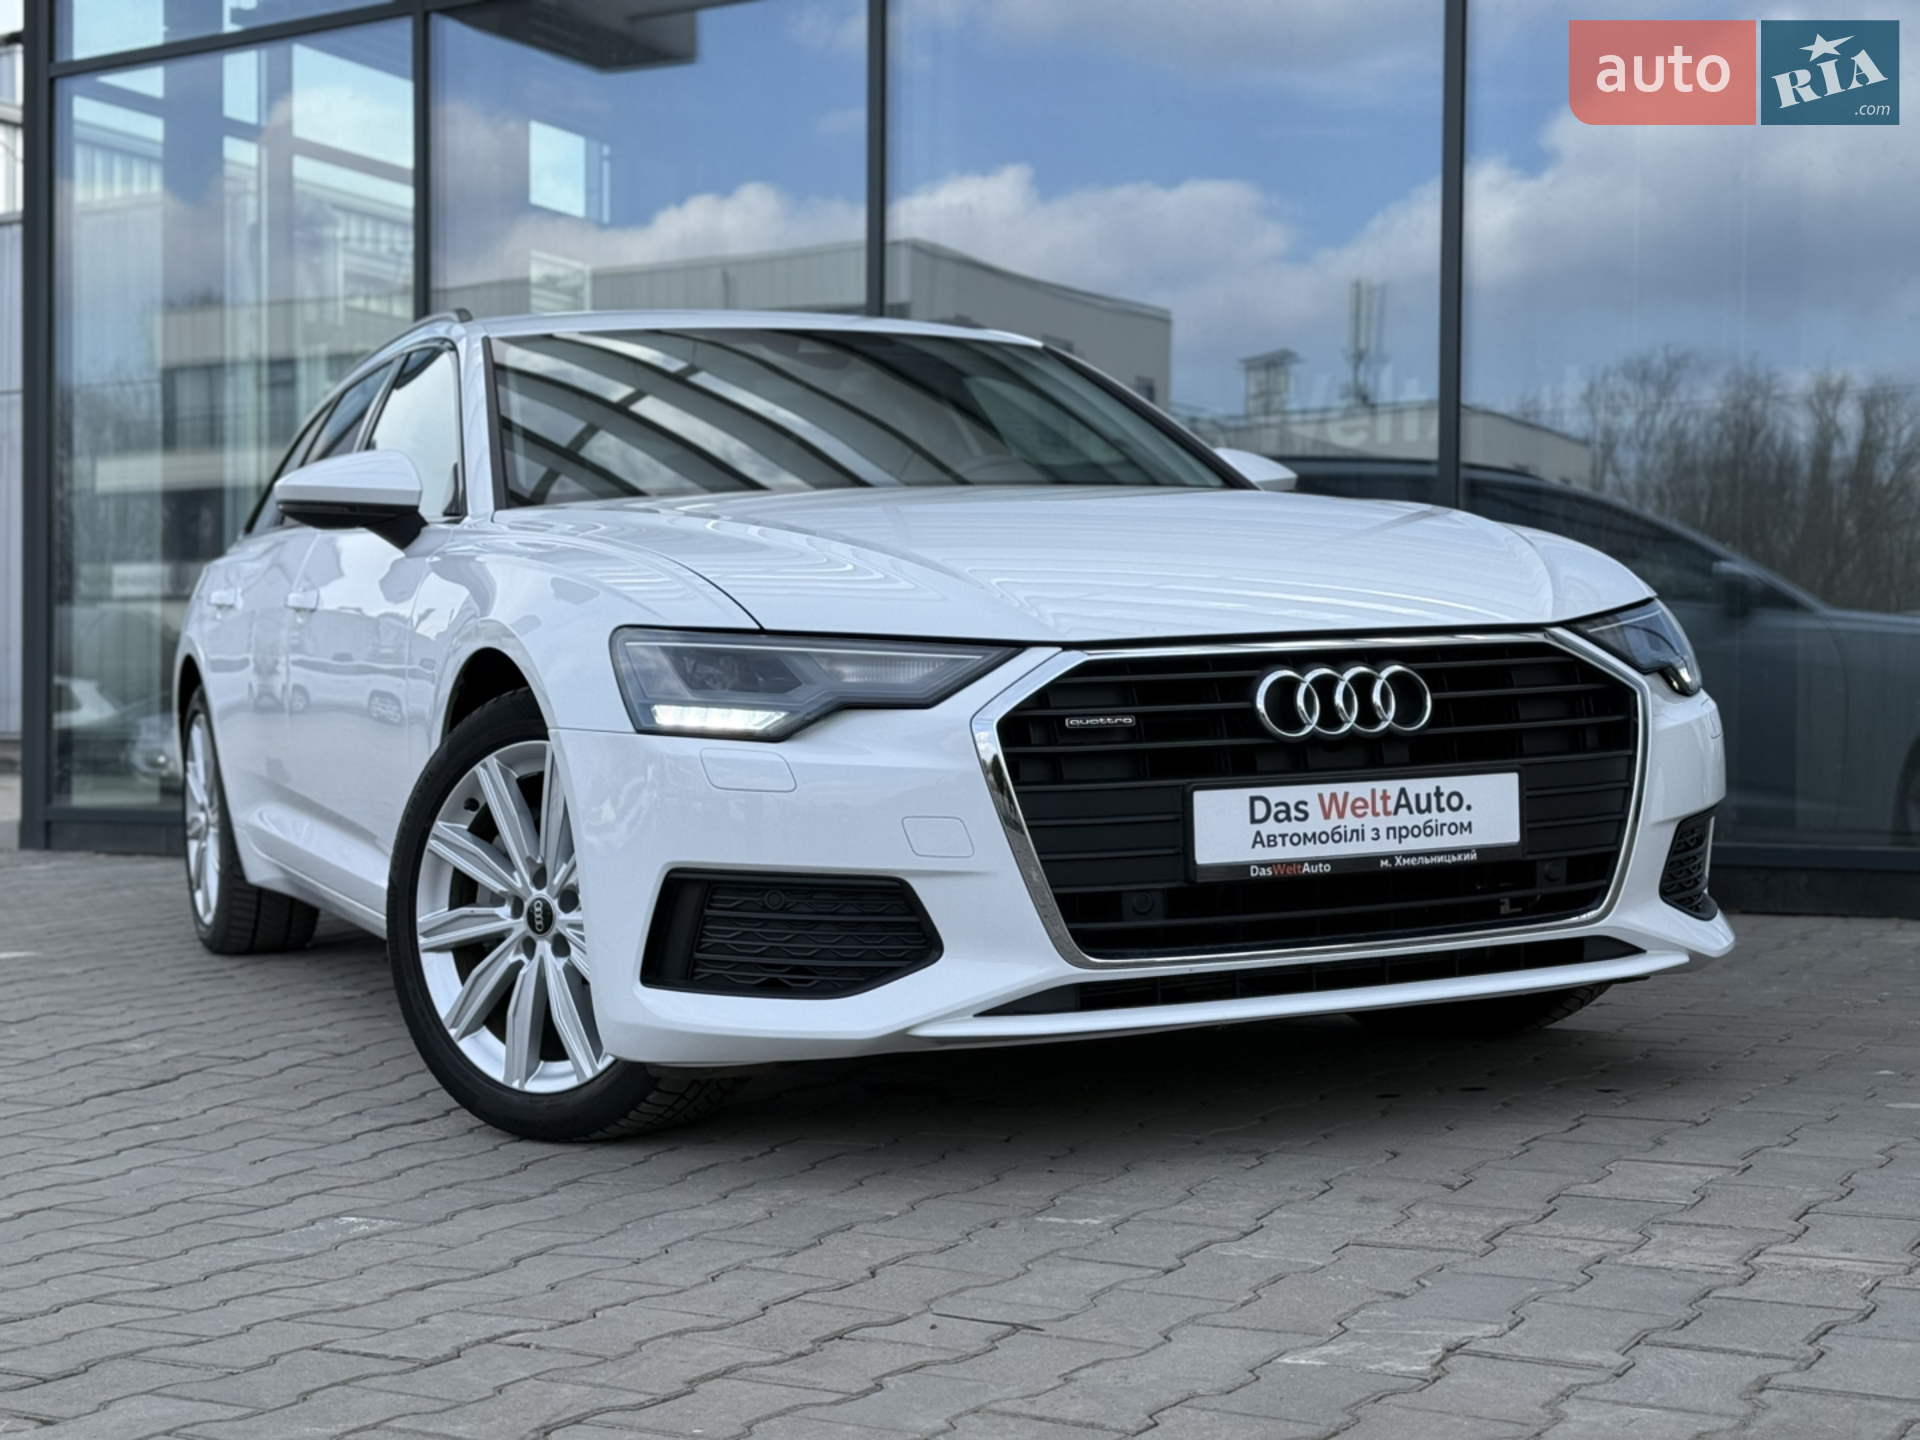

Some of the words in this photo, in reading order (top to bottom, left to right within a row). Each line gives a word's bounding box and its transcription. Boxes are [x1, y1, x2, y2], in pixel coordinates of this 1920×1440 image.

[1069, 717, 1133, 727] quattro
[1248, 795, 1309, 825] Das
[1317, 785, 1473, 821] WeltAuto.
[1250, 823, 1366, 849] Автомобілі
[1370, 827, 1381, 842] з
[1386, 819, 1473, 844] пробігом
[1380, 858, 1393, 868] м.
[1394, 848, 1478, 867] Хмельницький
[1249, 862, 1332, 877] DasWeltAuto
